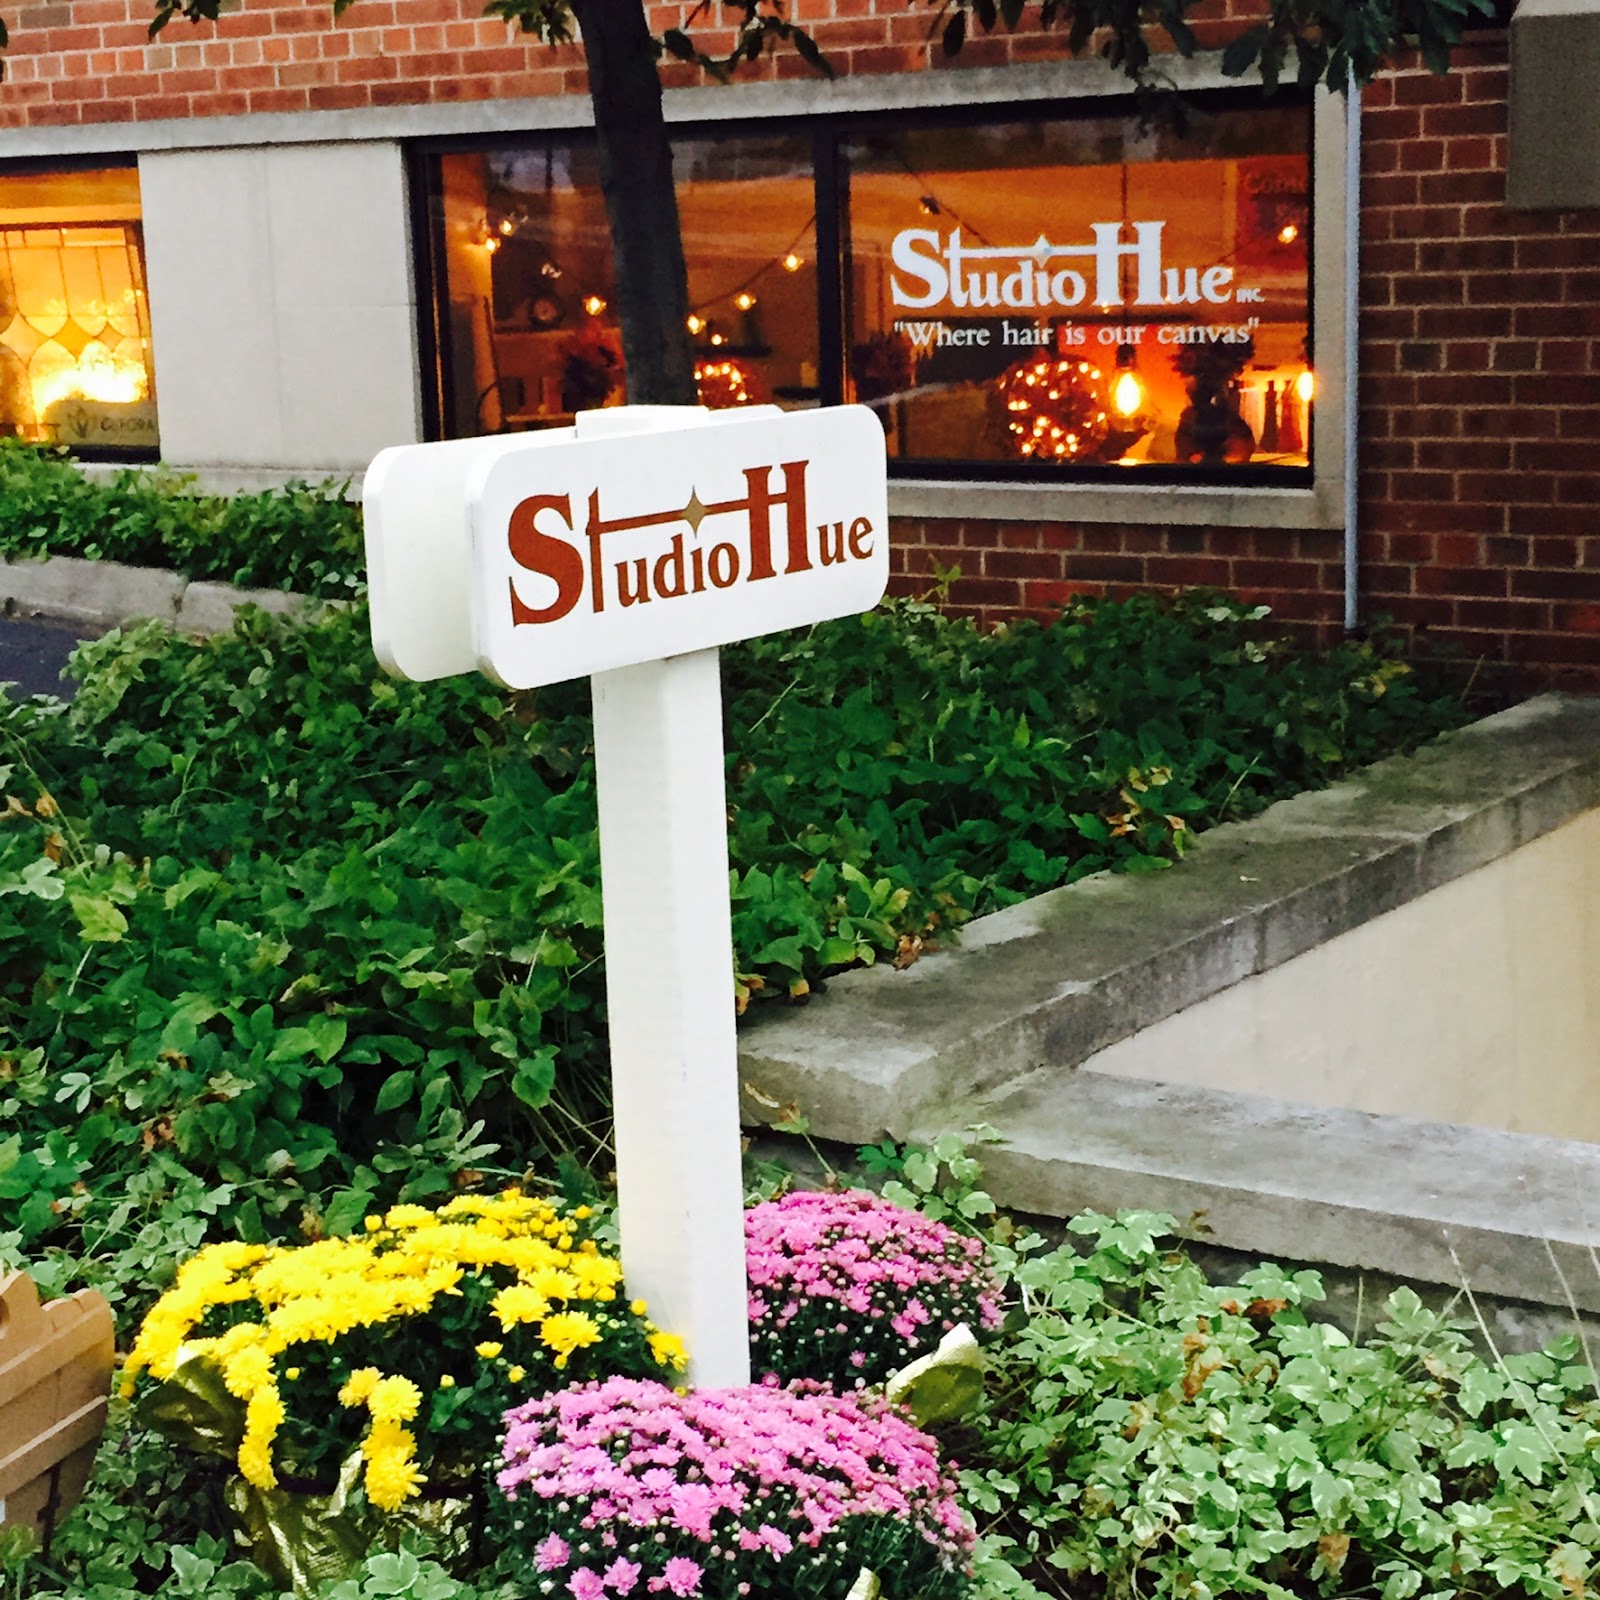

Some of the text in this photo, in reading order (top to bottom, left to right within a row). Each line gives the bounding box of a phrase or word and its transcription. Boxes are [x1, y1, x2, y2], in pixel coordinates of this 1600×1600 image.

[890, 225, 1088, 308] Studio
[1090, 220, 1235, 307] Hue
[894, 317, 1261, 347] "Where hair is our canvas"
[508, 460, 875, 627] Studio Hue
